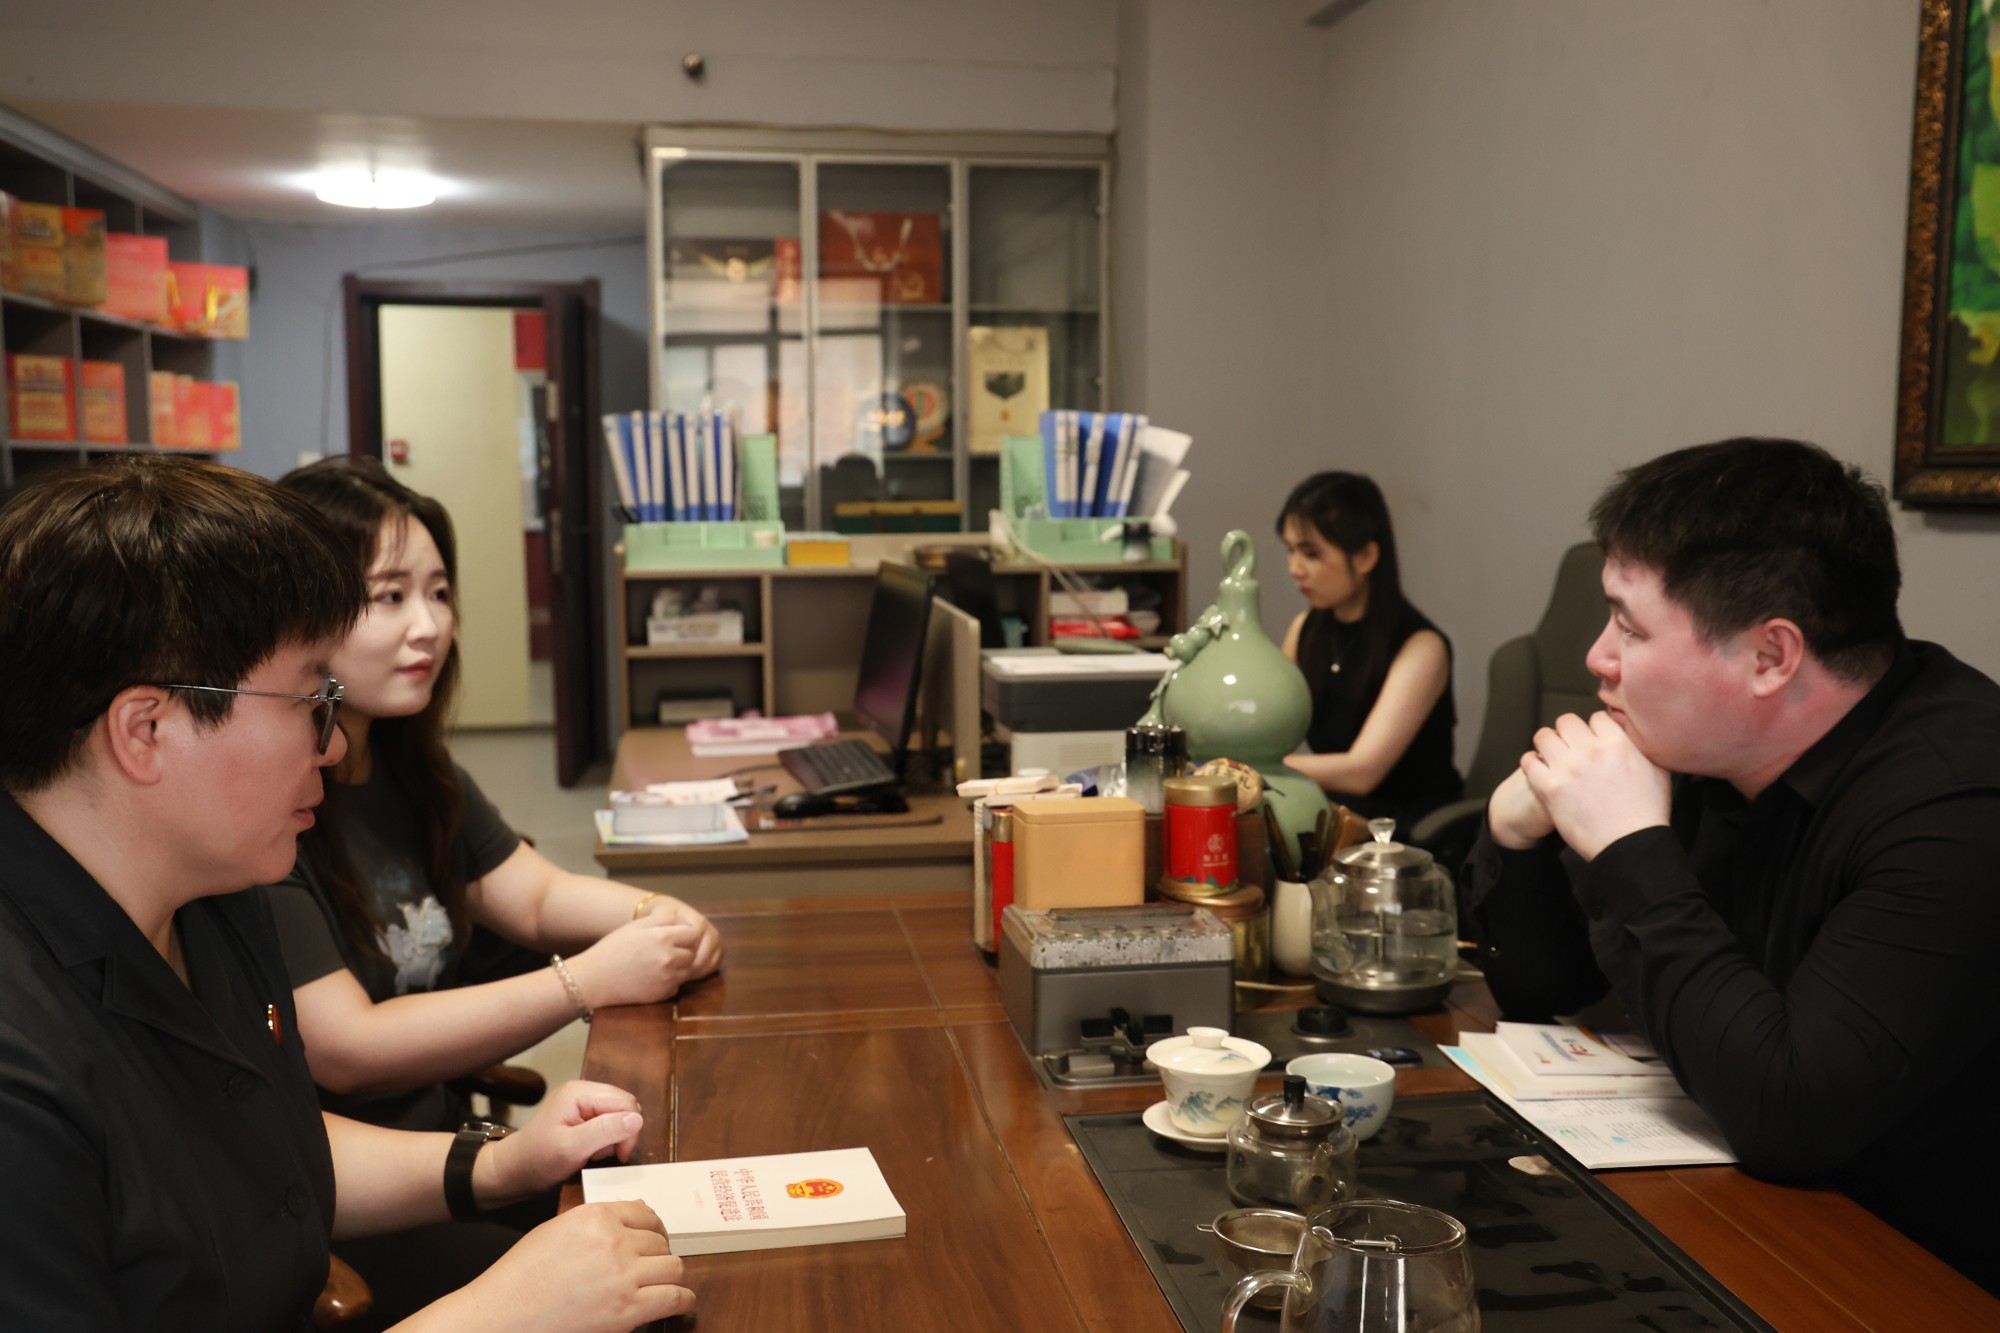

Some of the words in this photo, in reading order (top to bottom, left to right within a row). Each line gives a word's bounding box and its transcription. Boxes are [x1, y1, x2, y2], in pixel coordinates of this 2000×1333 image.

[734, 1168, 769, 1220] 中华人民共和国
